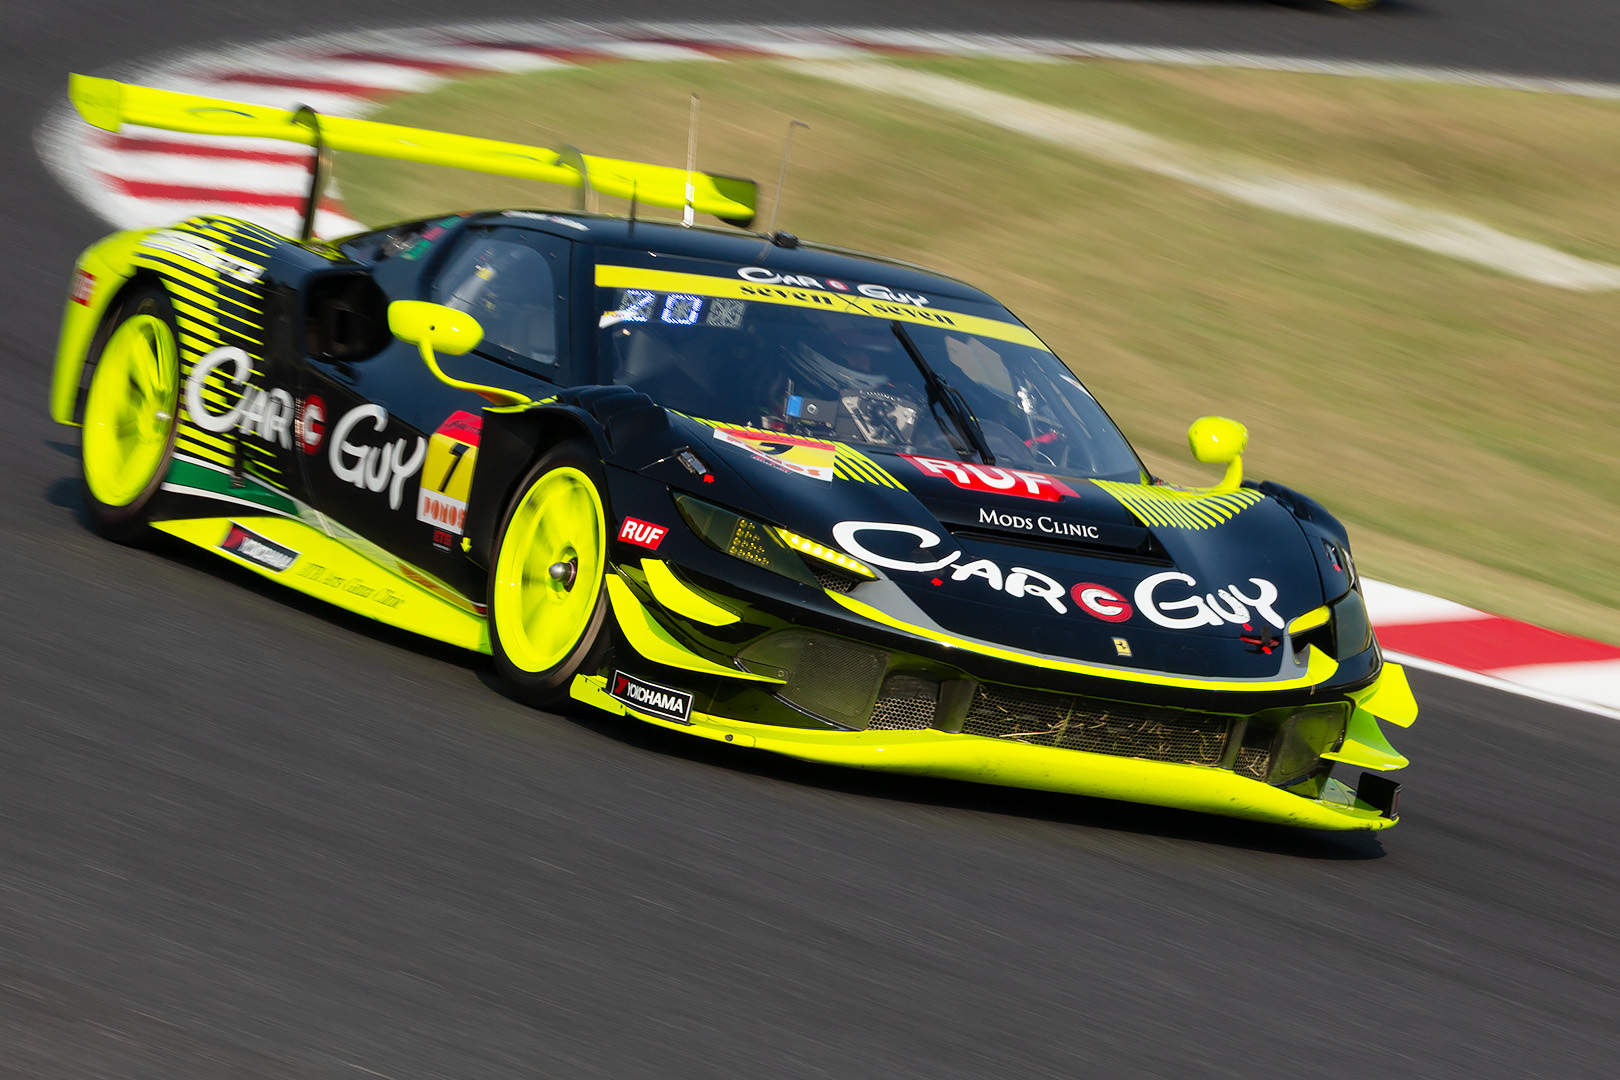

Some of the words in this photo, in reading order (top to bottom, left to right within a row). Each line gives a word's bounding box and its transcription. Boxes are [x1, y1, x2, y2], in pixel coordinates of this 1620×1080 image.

[739, 284, 833, 306] seven
[871, 302, 957, 327] seven
[329, 403, 428, 510] GUY
[438, 442, 470, 493] 7
[912, 456, 1052, 495] RUF
[620, 519, 664, 545] RUF
[1134, 571, 1285, 629] GUY
[626, 681, 684, 714] YOKOHAMA
